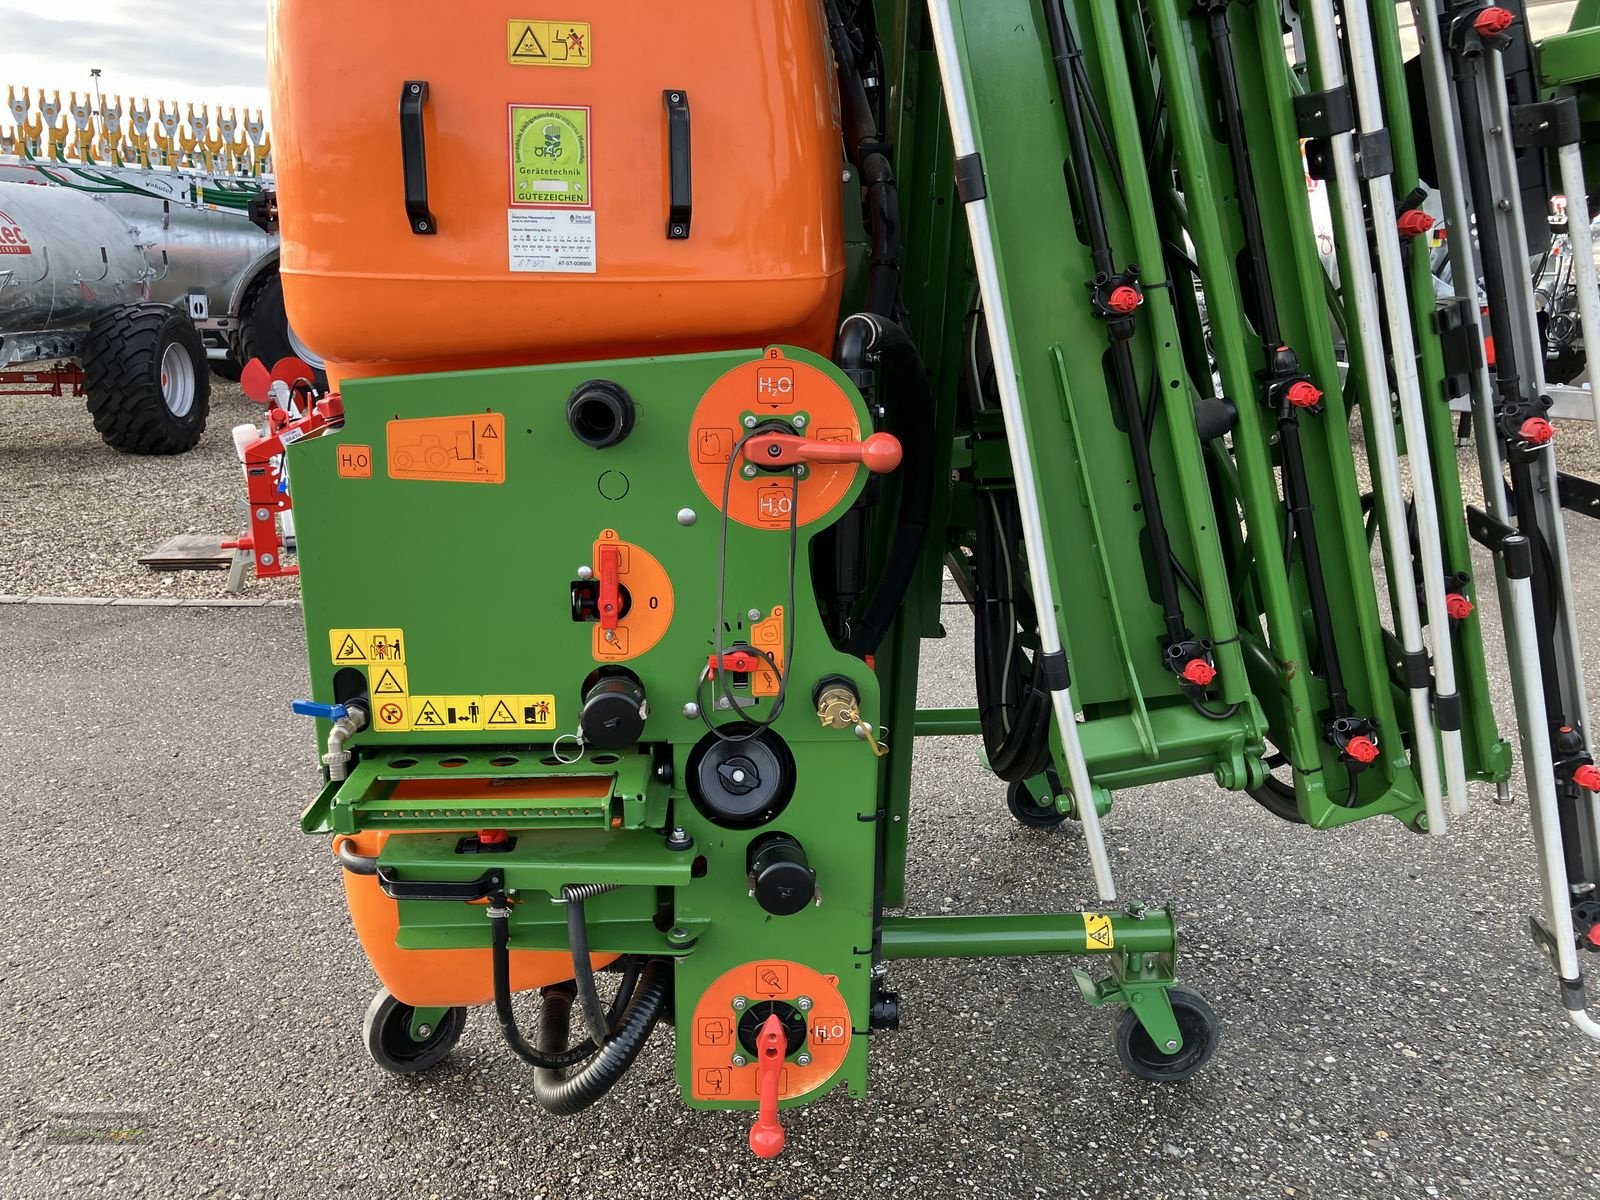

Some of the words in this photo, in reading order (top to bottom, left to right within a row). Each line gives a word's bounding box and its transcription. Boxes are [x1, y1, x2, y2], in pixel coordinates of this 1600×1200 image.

[519, 166, 581, 176] Gerätetechnik
[518, 191, 583, 202] GÜTEZEICHEN
[770, 349, 778, 359] B
[759, 376, 793, 397] H2O
[342, 453, 368, 470] H2O
[760, 496, 792, 517] H2O
[605, 530, 613, 539] D
[649, 596, 658, 610] 0
[774, 608, 782, 616] C
[815, 1024, 844, 1041] H2O
